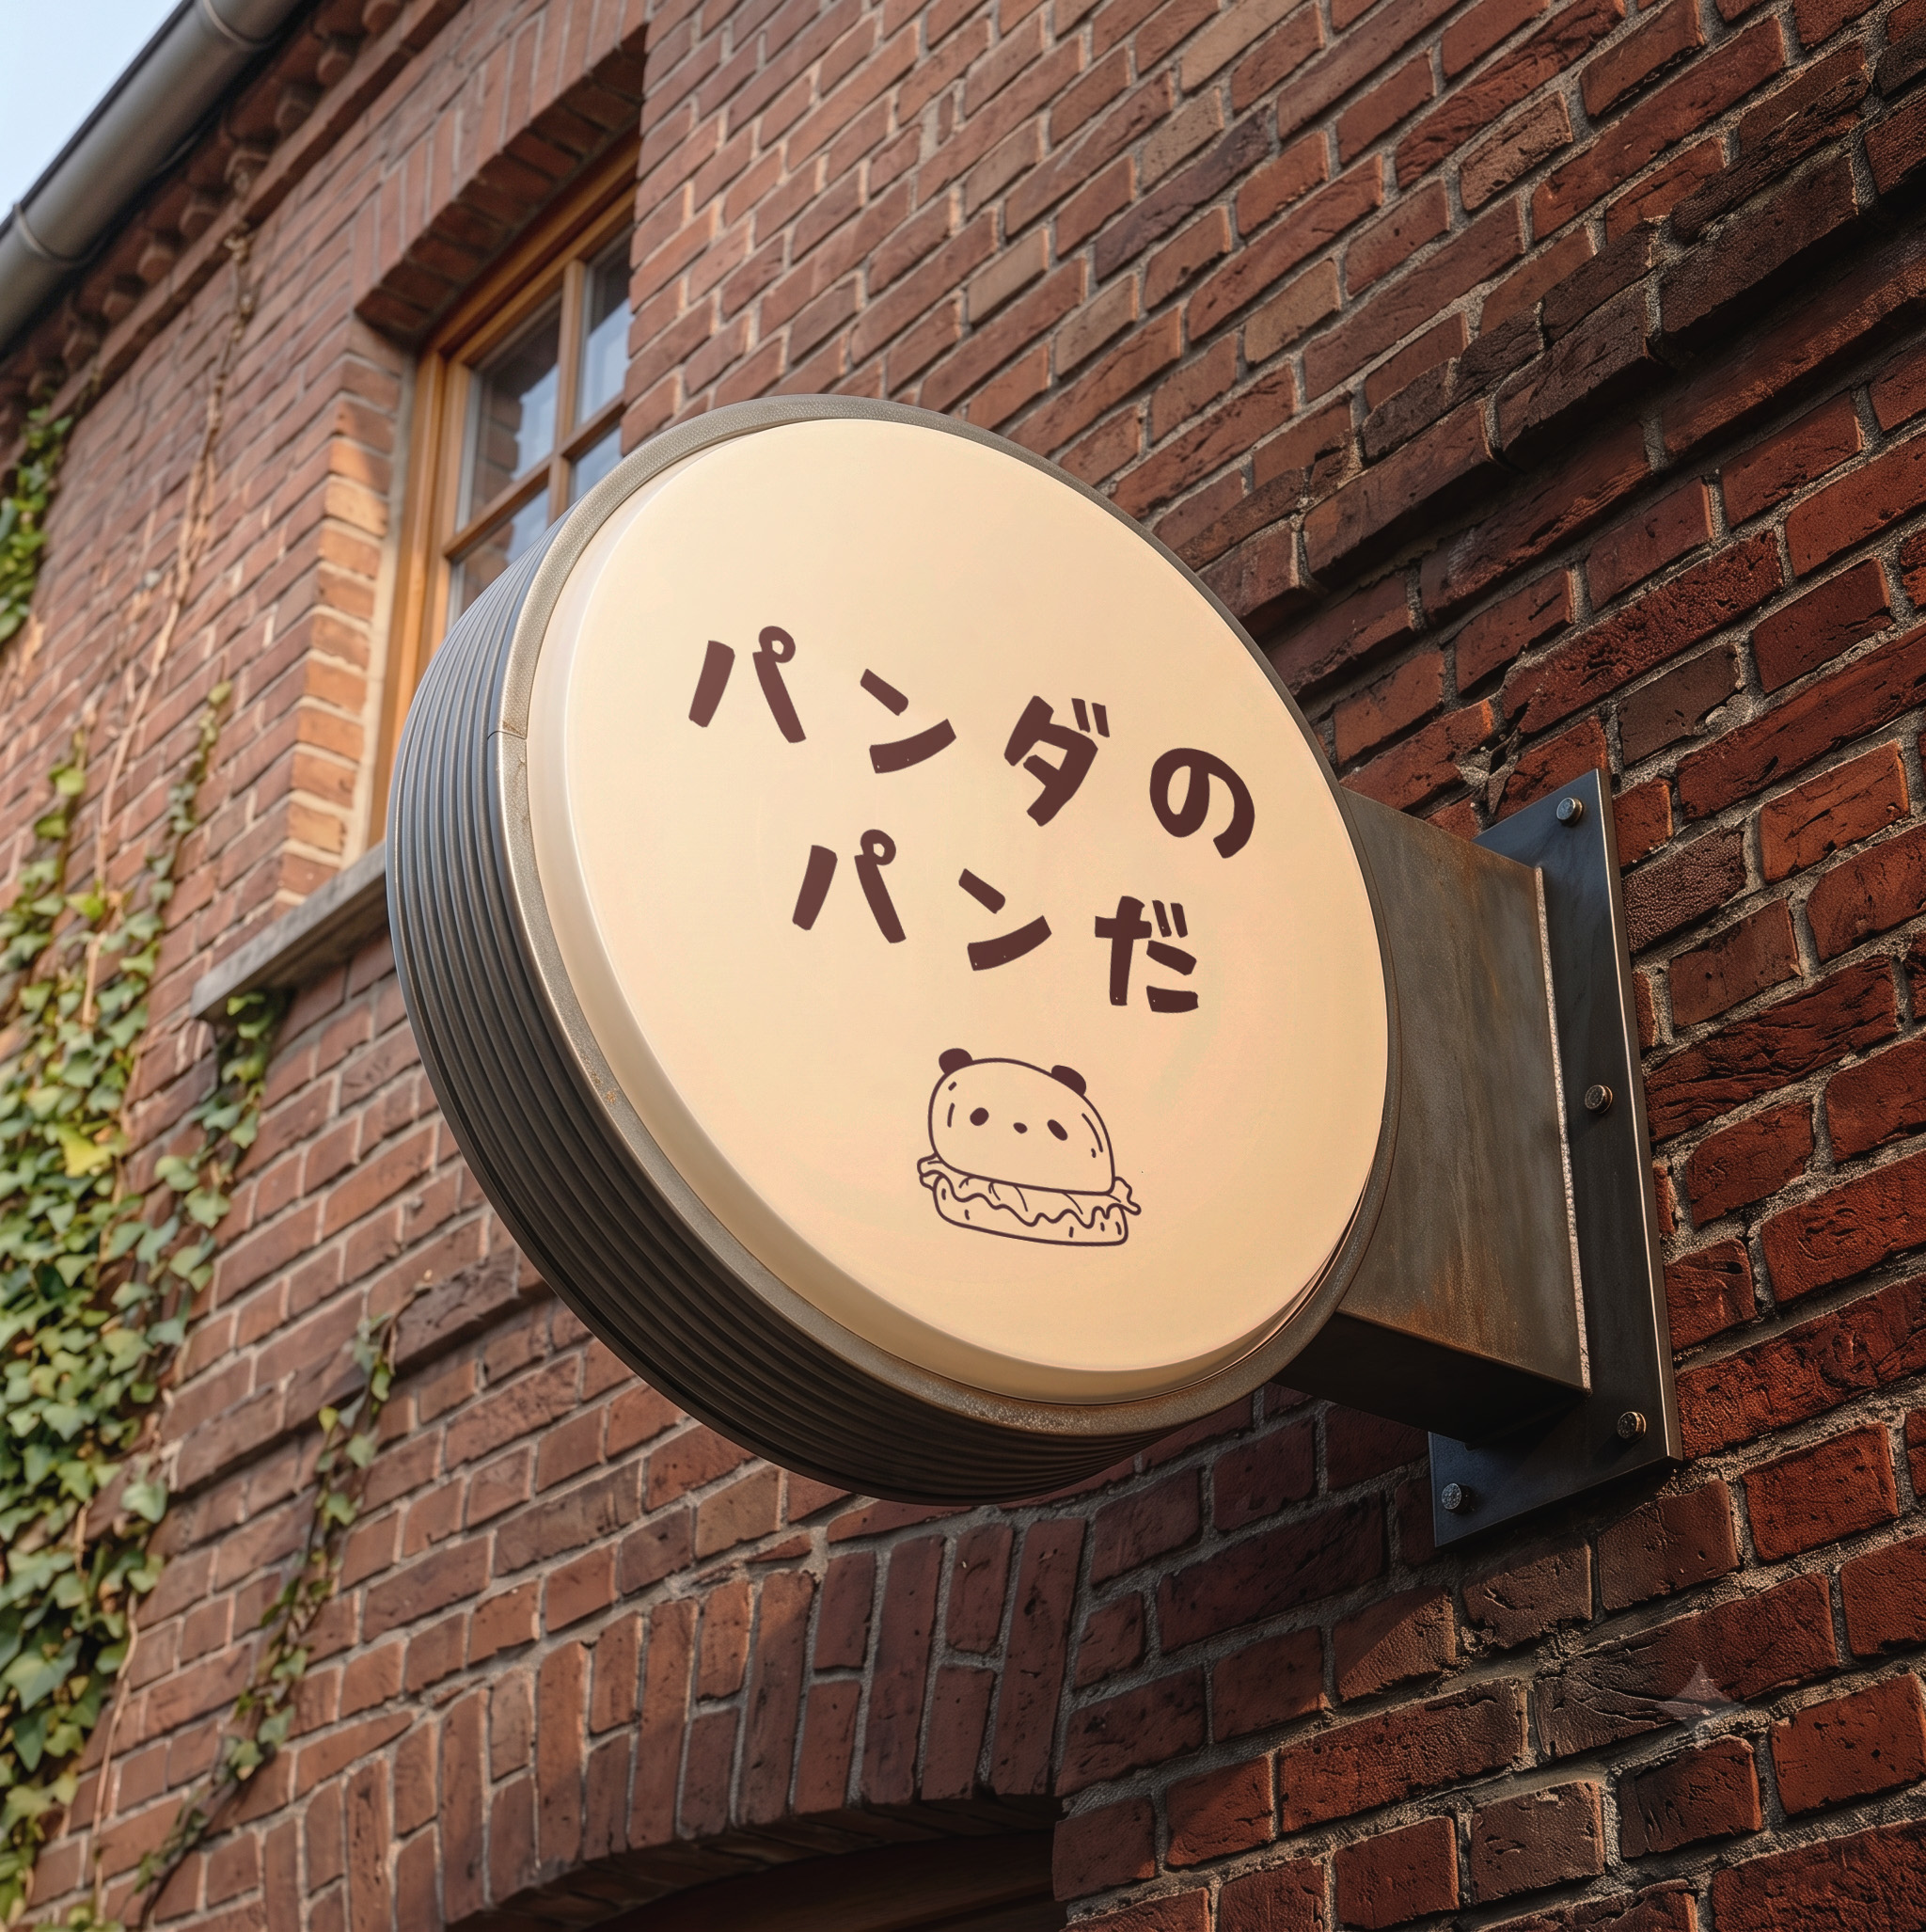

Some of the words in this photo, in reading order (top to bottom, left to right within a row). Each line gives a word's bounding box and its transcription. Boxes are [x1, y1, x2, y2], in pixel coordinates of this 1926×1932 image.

[688, 626, 1255, 860] パンダの
[792, 829, 1199, 1014] パンだ
